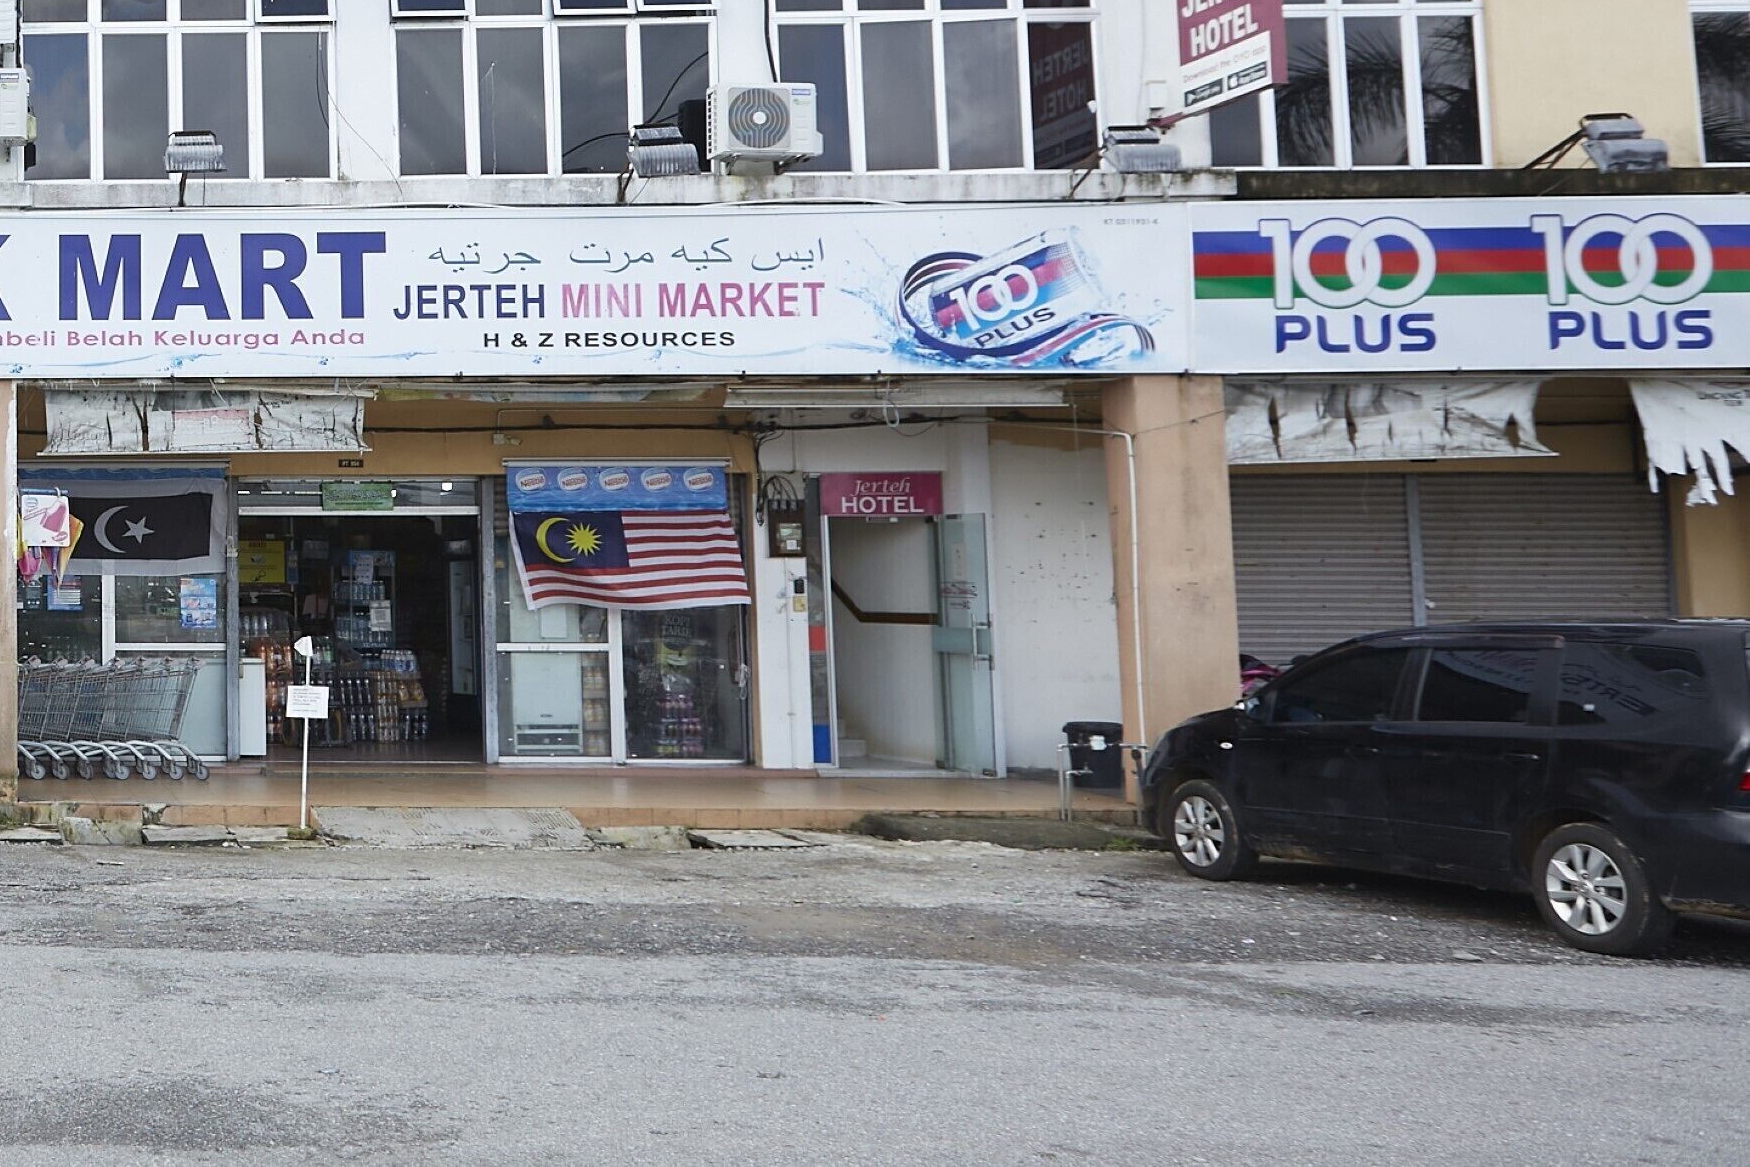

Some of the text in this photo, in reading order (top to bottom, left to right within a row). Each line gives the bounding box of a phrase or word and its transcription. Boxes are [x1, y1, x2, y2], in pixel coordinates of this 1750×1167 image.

[1189, 3, 1259, 58] HOTEL
[58, 231, 387, 322] MART
[1258, 216, 1437, 310] 100
[1530, 211, 1714, 307] 100
[393, 281, 826, 320] JERTEH MINI MARKET
[949, 263, 1039, 332] 100
[66, 330, 143, 347] Belah
[154, 329, 280, 353] Keluarga
[289, 328, 365, 346] Anda
[483, 331, 736, 348] H & Z RESOURCES
[973, 307, 1056, 348] PLUS
[1275, 312, 1437, 354] PLUS
[1549, 309, 1714, 351] PLUS
[841, 496, 925, 514] HOTEL
[850, 477, 911, 496] Jerteh
